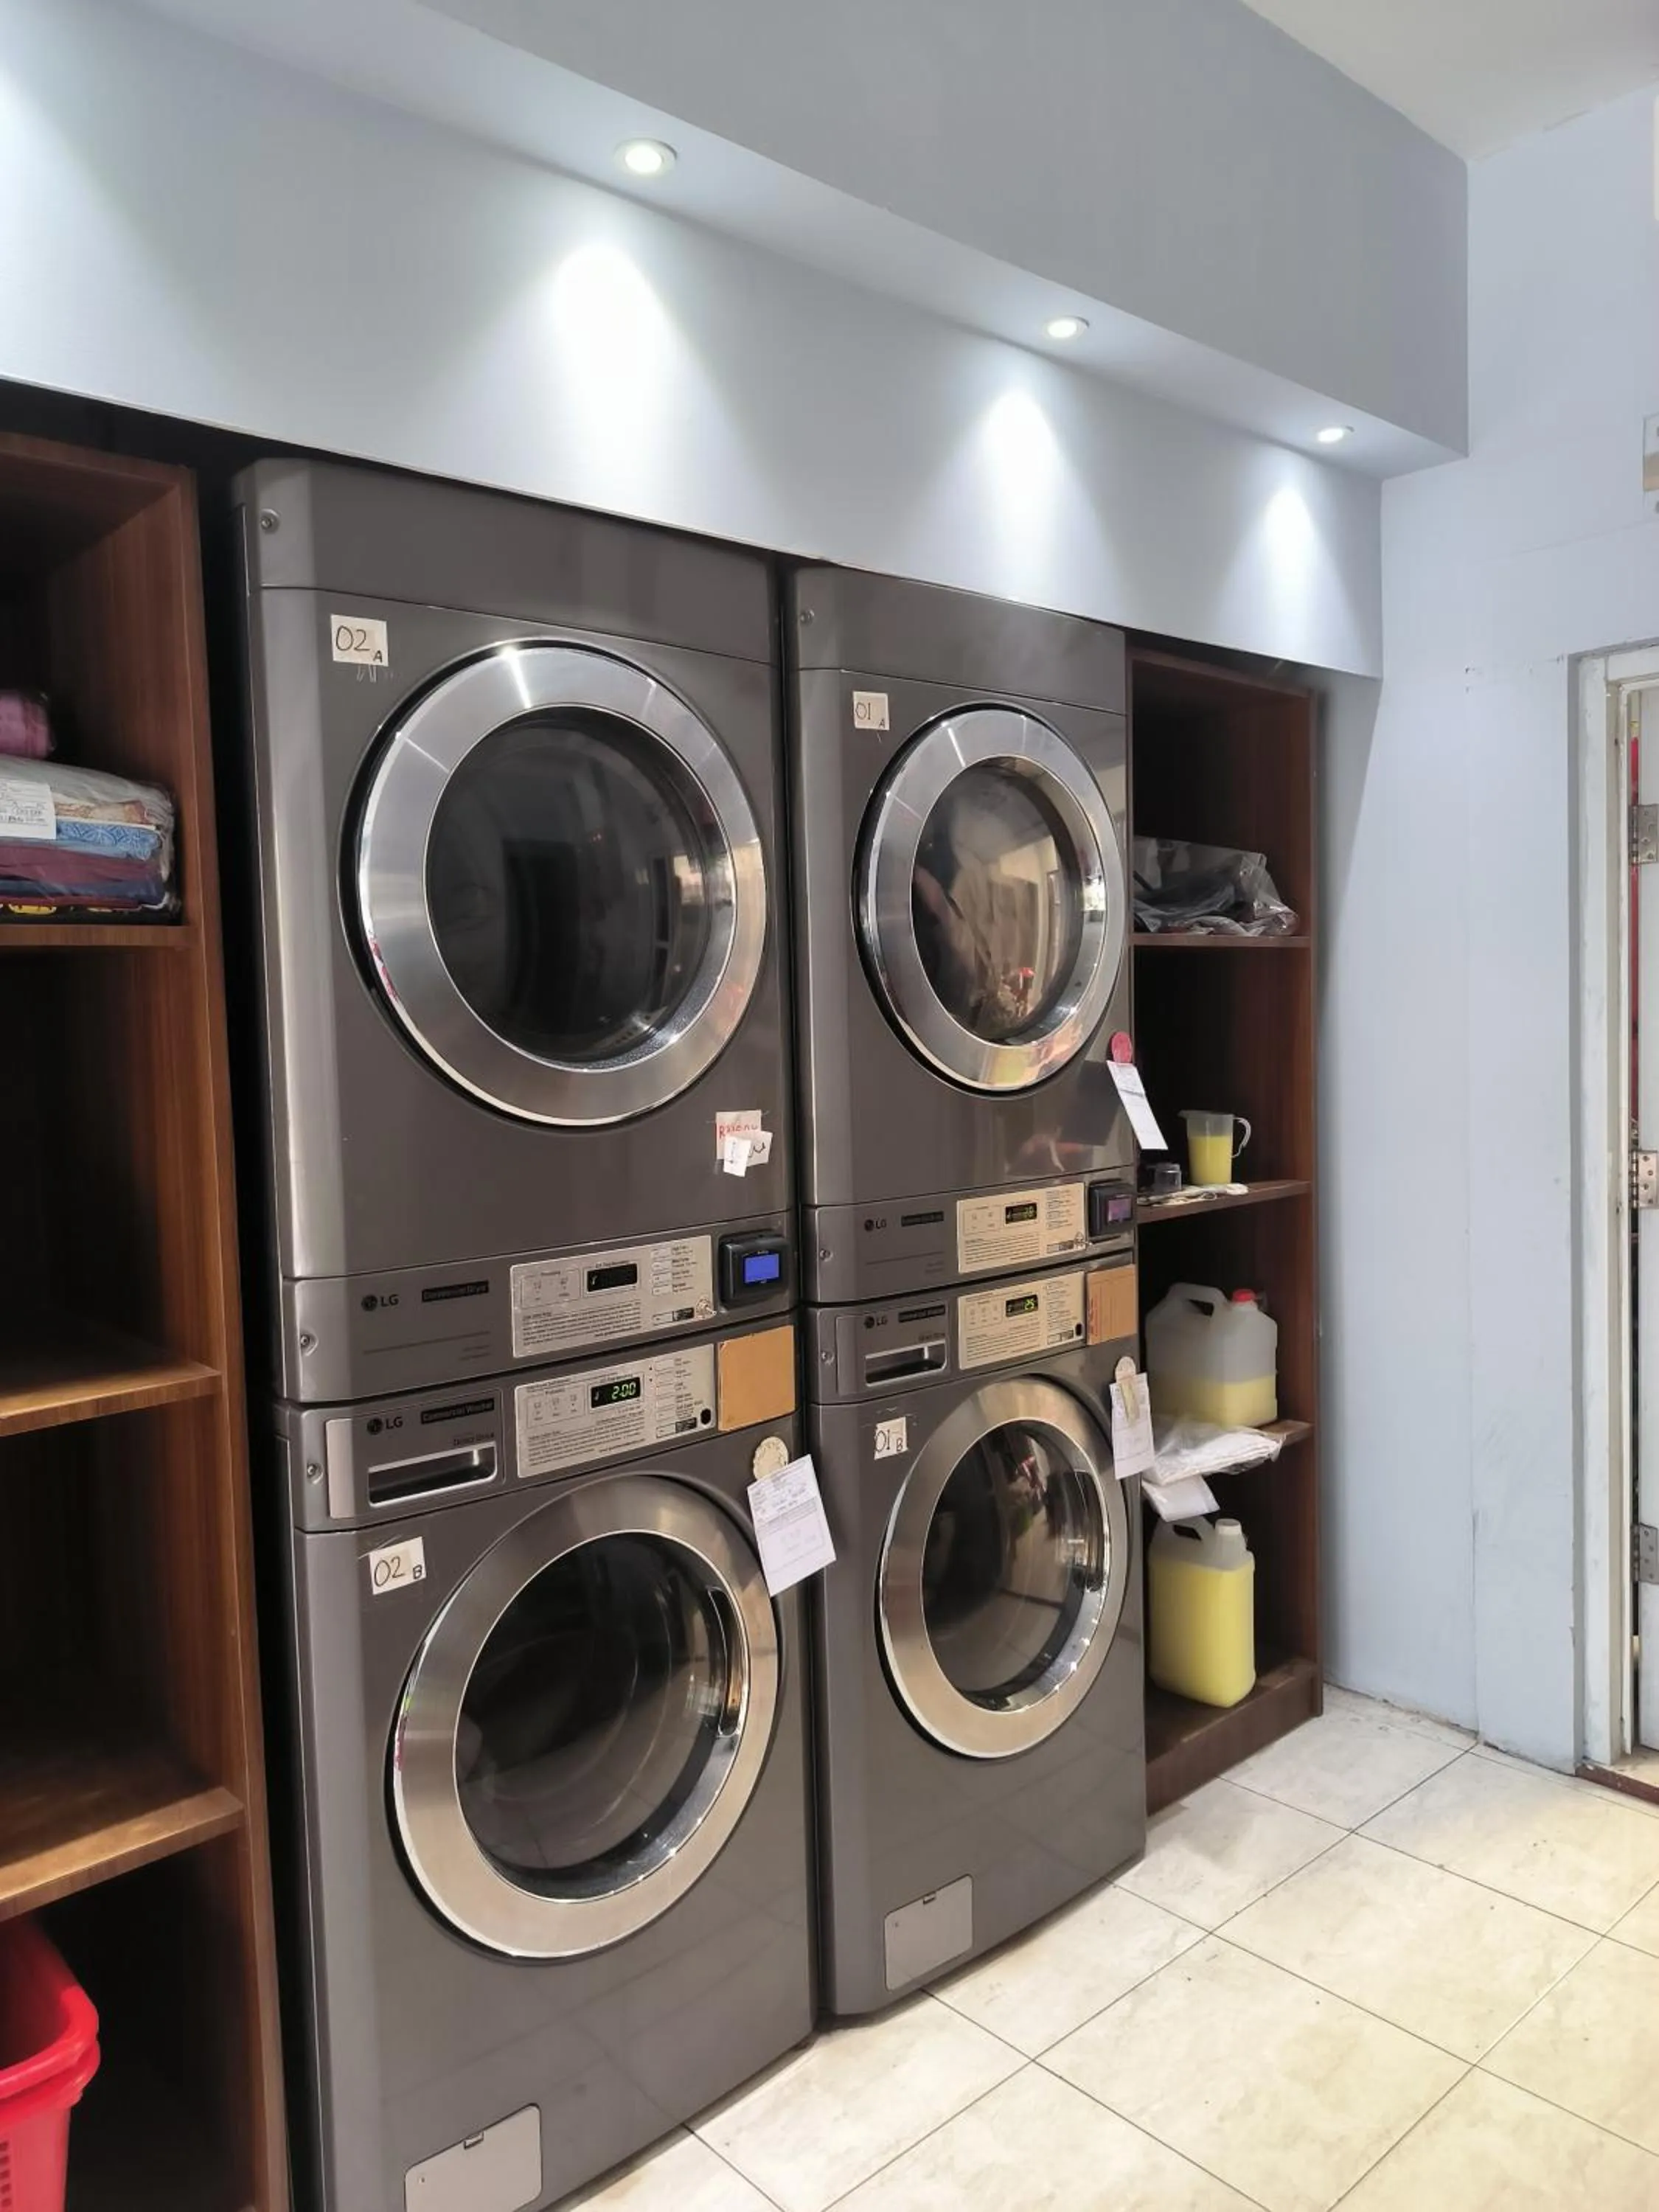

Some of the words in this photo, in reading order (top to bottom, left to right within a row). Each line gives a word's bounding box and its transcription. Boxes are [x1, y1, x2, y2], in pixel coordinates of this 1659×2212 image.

[335, 625, 370, 651] 02
[373, 650, 383, 664] A
[879, 718, 886, 729] A
[380, 1293, 400, 1307] LG
[386, 1416, 403, 1430] LG
[374, 1555, 406, 1587] 02
[412, 1564, 423, 1579] B
